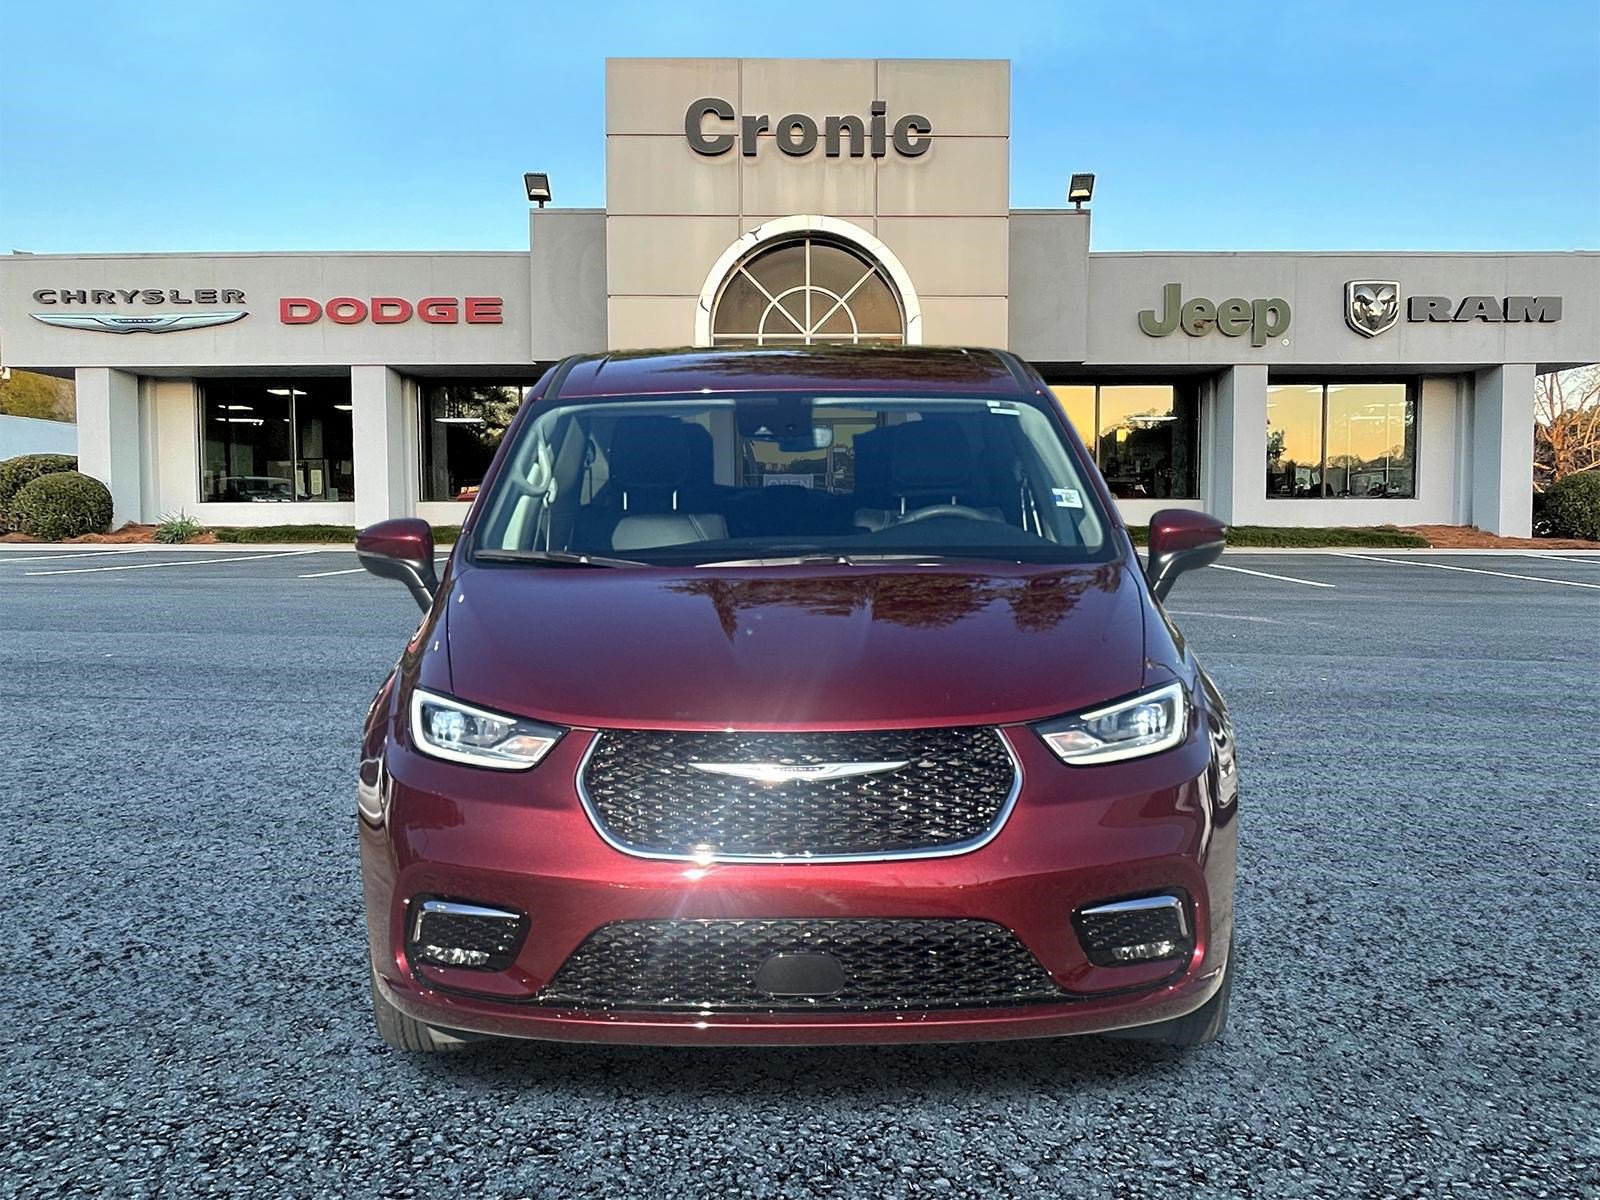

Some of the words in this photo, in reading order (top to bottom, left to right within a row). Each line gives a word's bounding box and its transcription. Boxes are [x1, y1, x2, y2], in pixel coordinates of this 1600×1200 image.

[685, 97, 932, 158] Cronic
[32, 288, 246, 305] CHRYSLER
[1407, 296, 1563, 323] RAM
[279, 297, 503, 325] DODGE
[1138, 283, 1291, 347] Jeep
